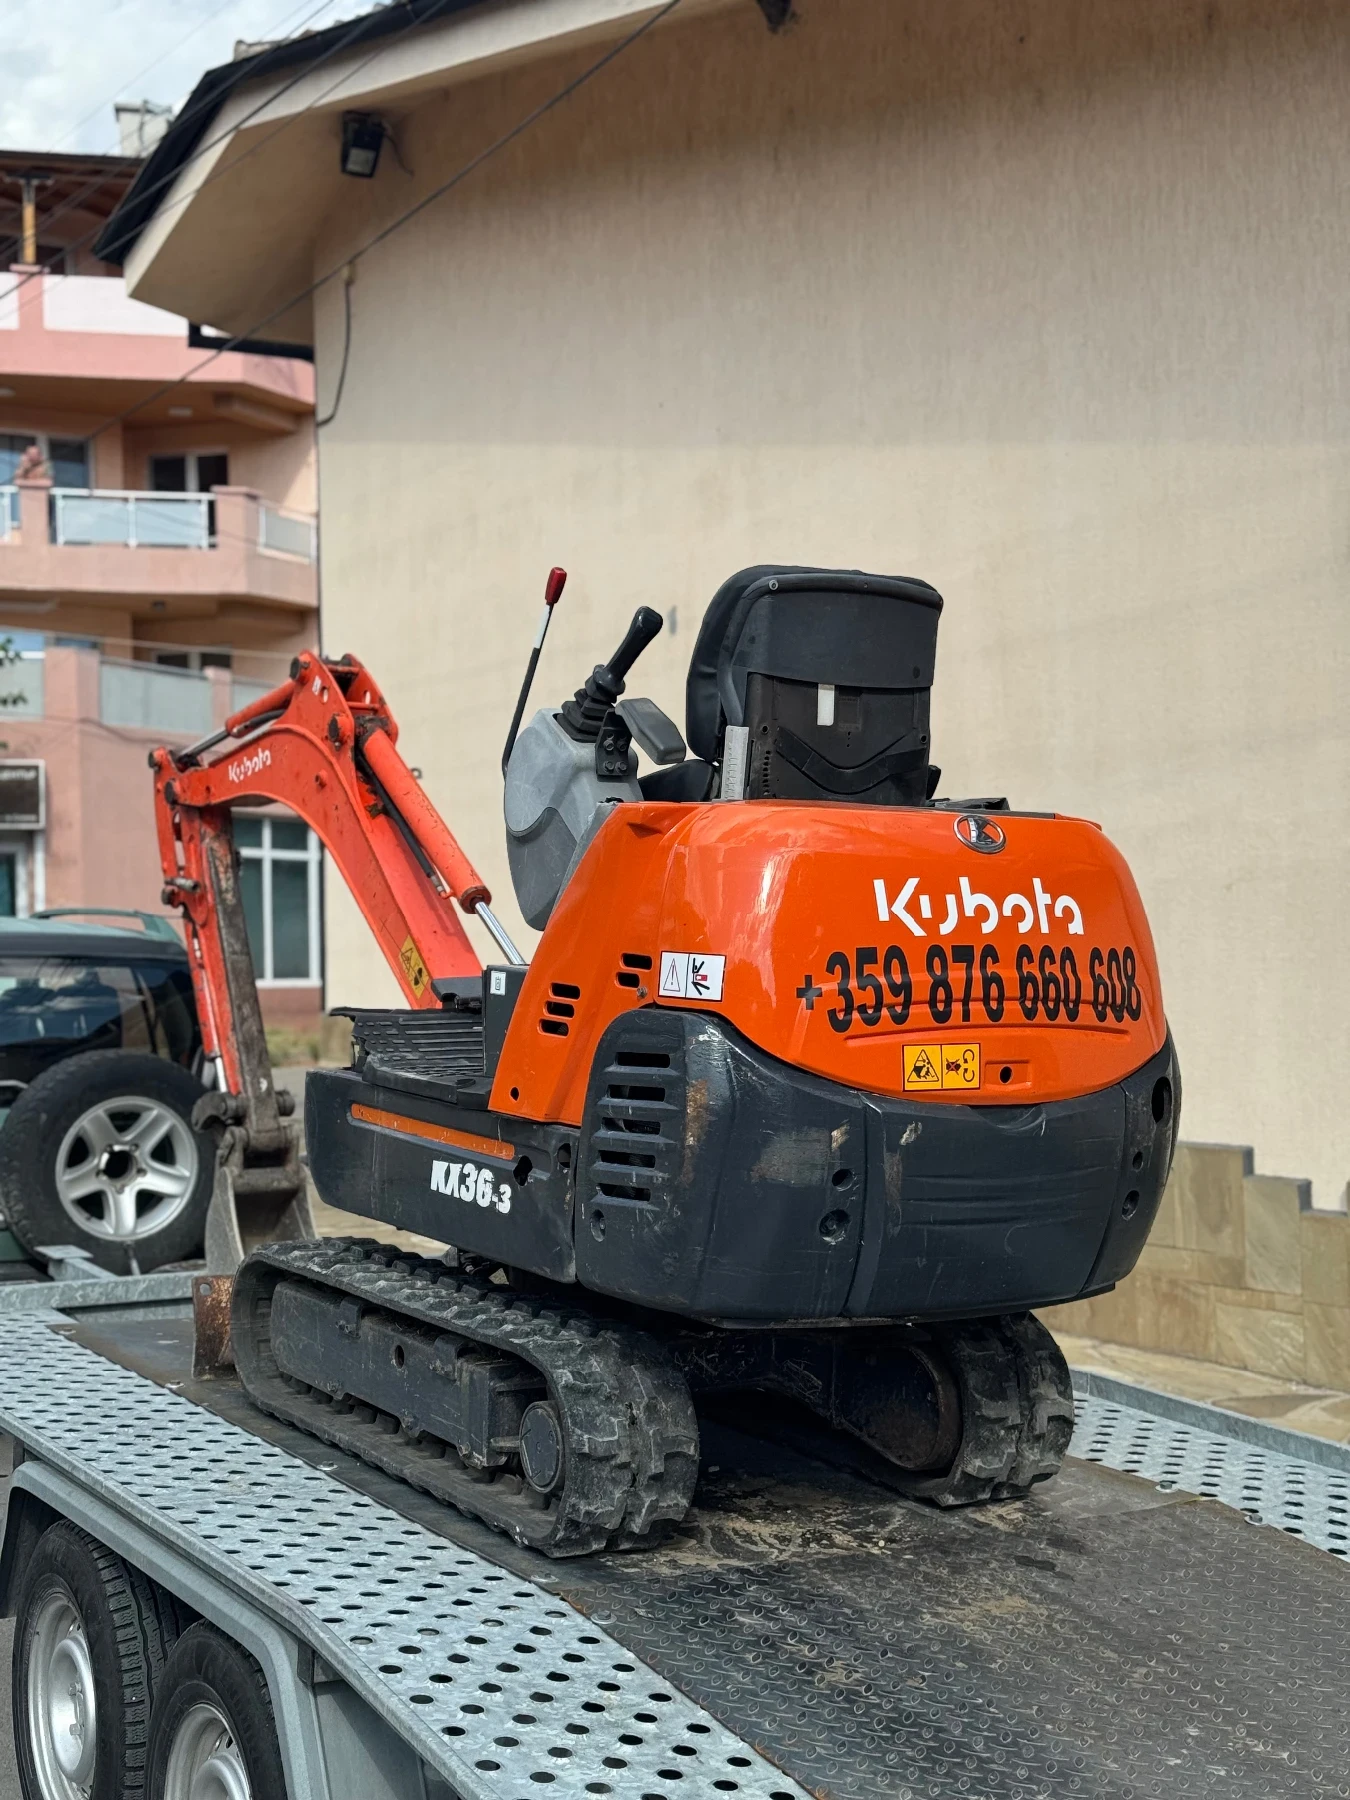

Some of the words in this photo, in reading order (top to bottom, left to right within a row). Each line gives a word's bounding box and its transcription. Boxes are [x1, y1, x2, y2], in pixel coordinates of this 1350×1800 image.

[228, 747, 271, 783] Kubota
[873, 876, 1084, 936] Kubota
[796, 943, 912, 1033] +359
[925, 943, 1005, 1024] 876
[1015, 943, 1082, 1022] 660
[1088, 945, 1142, 1023] 608
